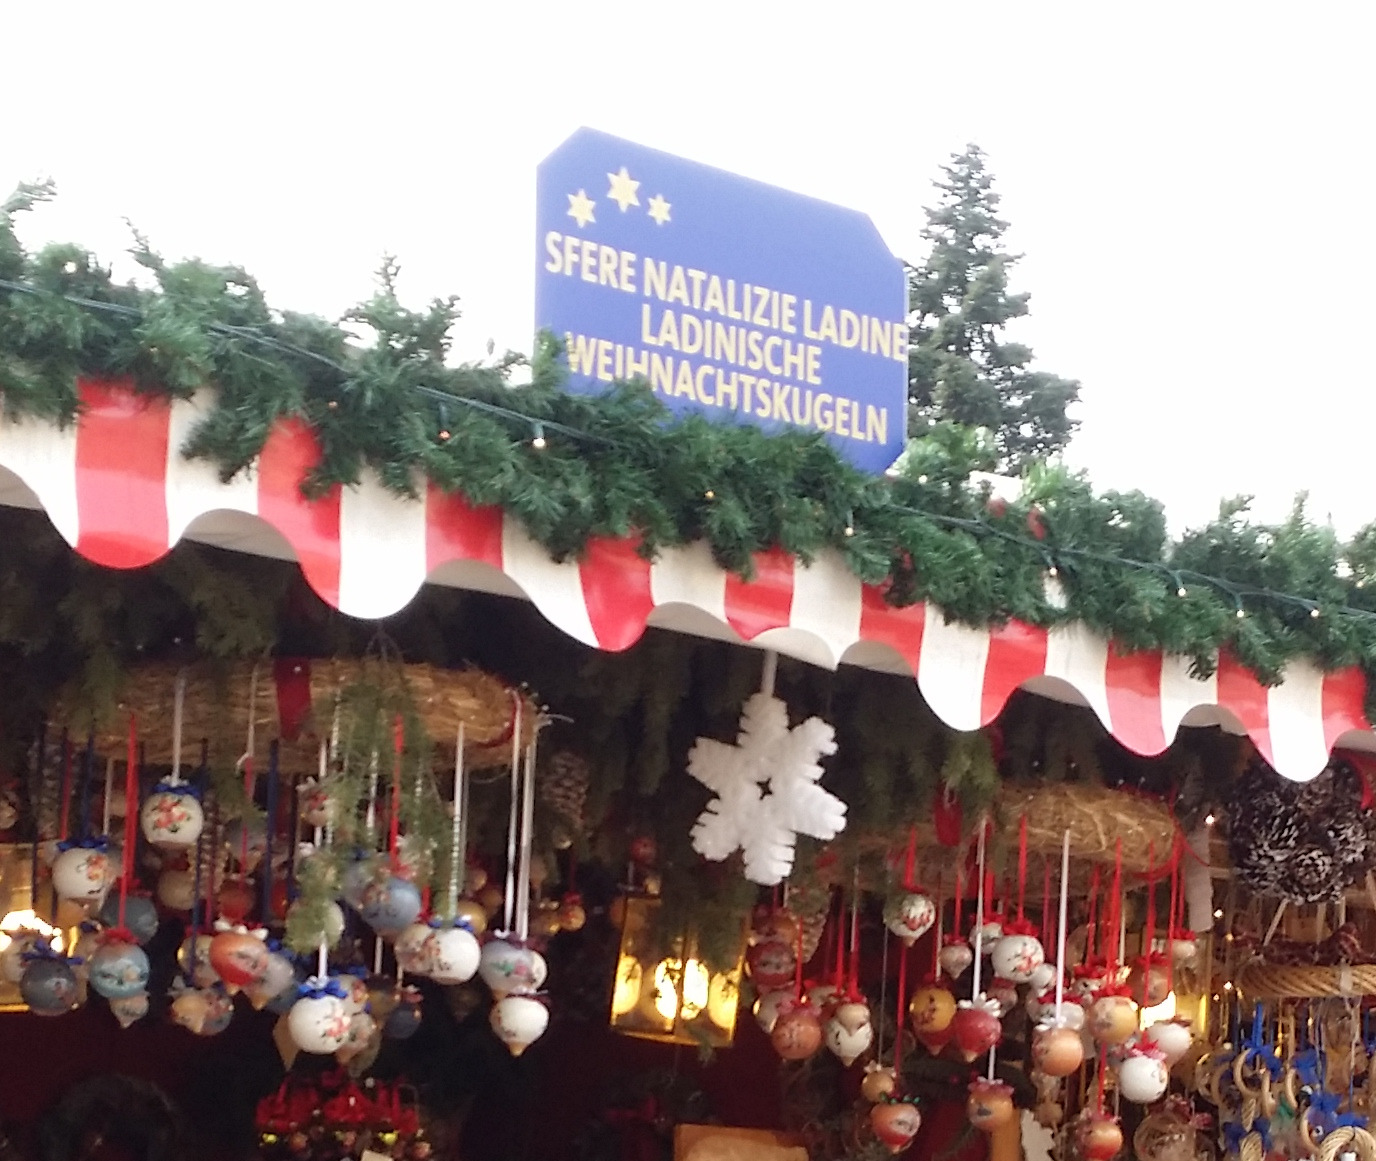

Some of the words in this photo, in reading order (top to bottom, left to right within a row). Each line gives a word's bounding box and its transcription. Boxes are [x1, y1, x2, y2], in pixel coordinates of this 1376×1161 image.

[544, 231, 636, 293] SFERE
[644, 257, 797, 333] NATALIZIE
[804, 300, 907, 362] LADINE
[641, 304, 822, 386] LADINISCHE
[564, 332, 887, 445] WEIHNACHTSKUGELN
